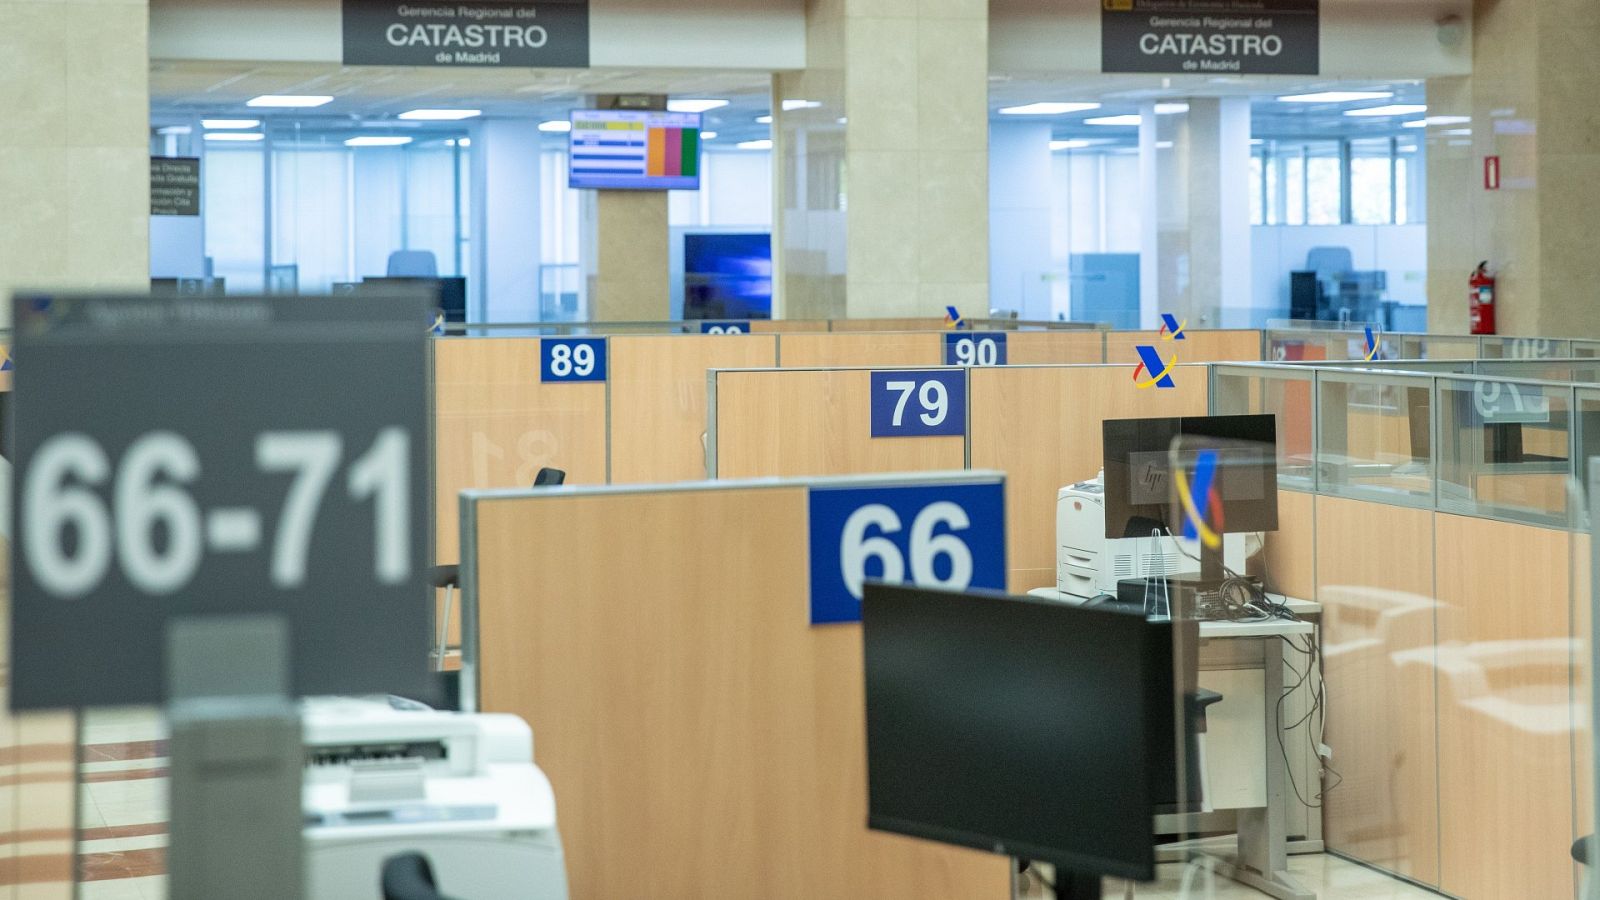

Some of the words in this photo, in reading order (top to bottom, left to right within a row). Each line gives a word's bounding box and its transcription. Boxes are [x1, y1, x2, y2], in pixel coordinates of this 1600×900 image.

[397, 5, 455, 18] Gerencia
[458, 6, 513, 20] Regional
[516, 7, 536, 18] del
[1149, 16, 1201, 28] Gerencia
[1203, 16, 1252, 30] Regional
[1254, 17, 1273, 28] del
[386, 23, 548, 48] CATASTRO
[1139, 33, 1282, 57] CATASTRO
[435, 52, 452, 62] de
[455, 52, 501, 63] Madrid
[1182, 61, 1198, 70] de
[1200, 61, 1241, 71] Madrid
[550, 343, 595, 377] 89
[955, 337, 998, 365] 90
[885, 380, 949, 427] 79
[21, 427, 412, 599] 66-71
[840, 500, 974, 601] 66
